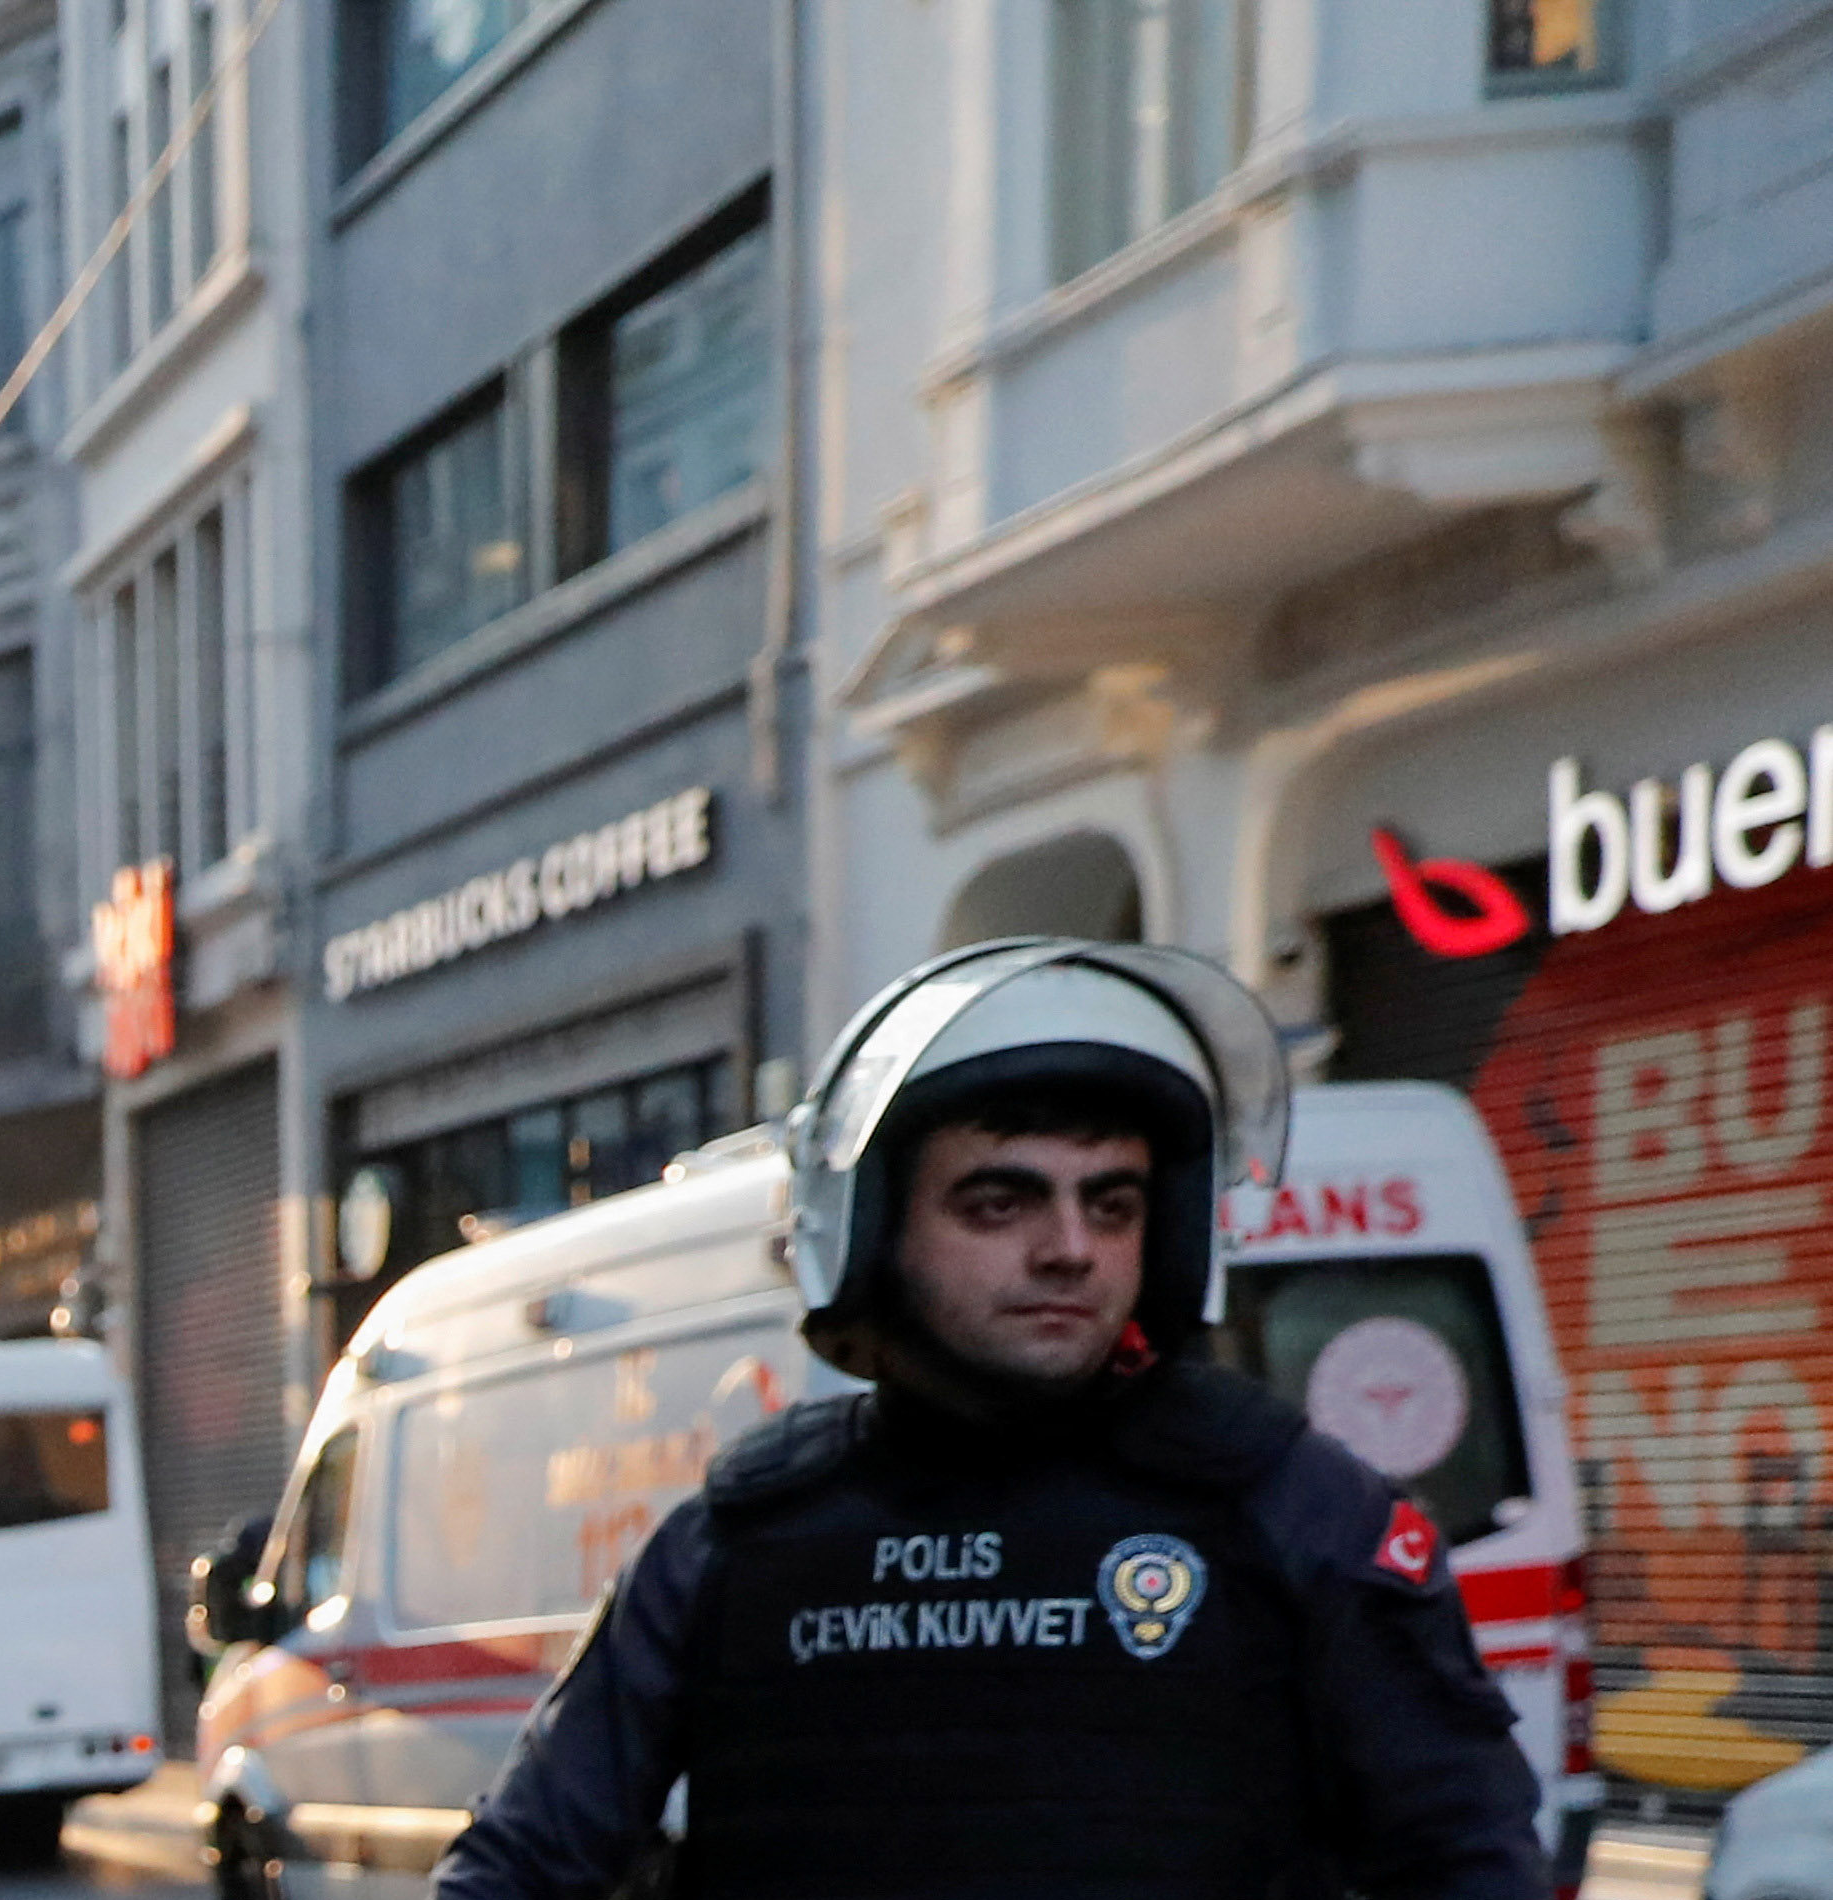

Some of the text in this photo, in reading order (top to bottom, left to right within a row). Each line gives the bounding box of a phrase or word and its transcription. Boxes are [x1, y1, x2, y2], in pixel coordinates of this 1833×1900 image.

[324, 856, 539, 1002] STARBUCKS
[539, 784, 712, 921] COFFEE
[916, 1597, 1093, 1648] KUVVET
